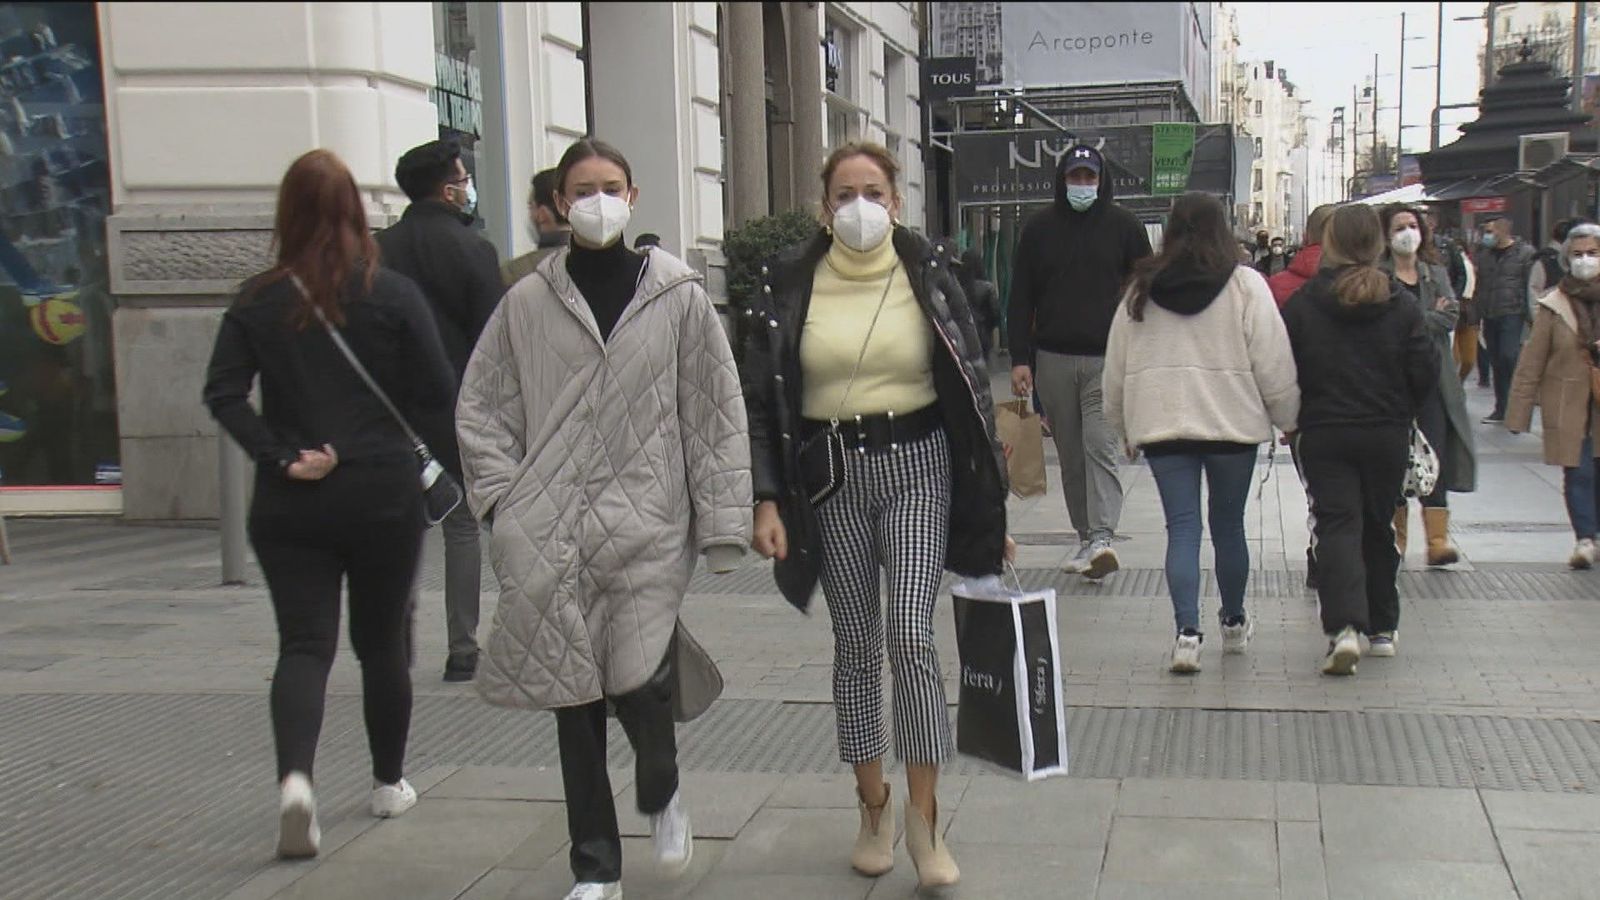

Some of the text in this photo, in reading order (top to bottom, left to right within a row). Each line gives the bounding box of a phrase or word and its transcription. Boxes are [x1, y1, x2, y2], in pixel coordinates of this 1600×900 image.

[1028, 29, 1153, 54] Arcoponte
[930, 73, 971, 85] TOUS
[972, 181, 1052, 193] PROFESSIO
